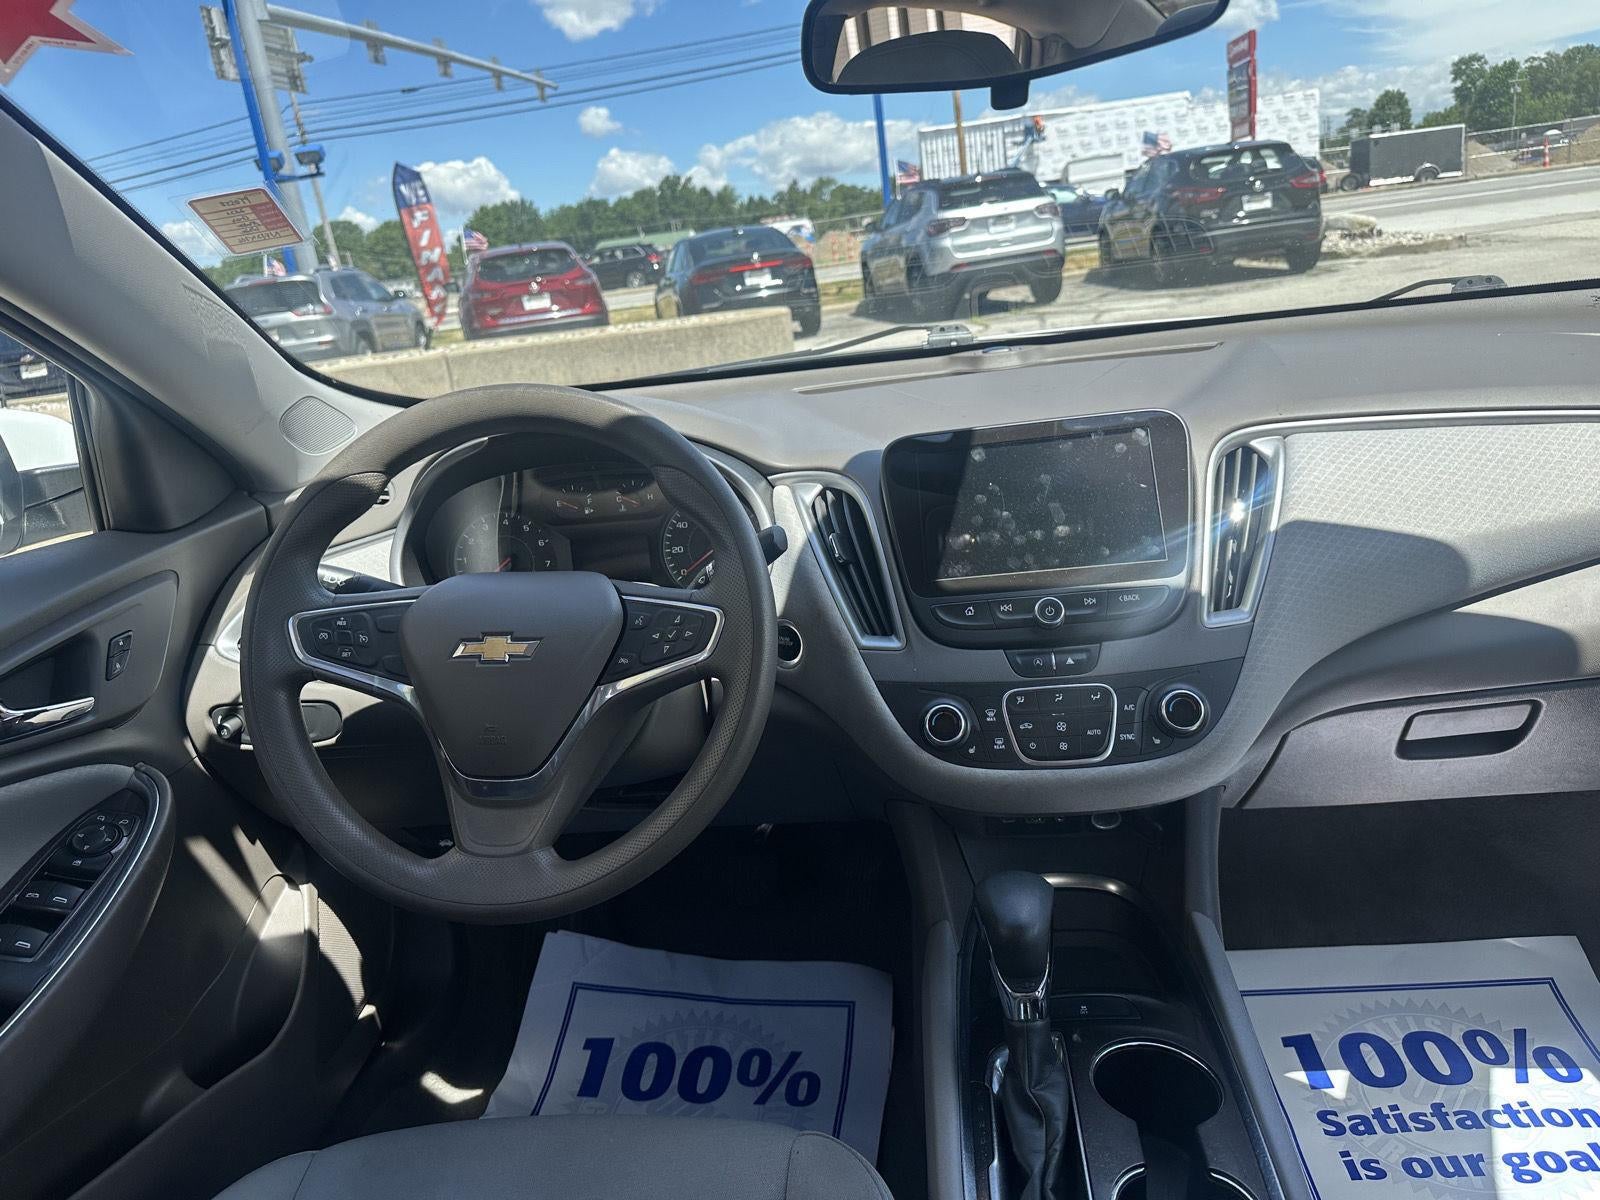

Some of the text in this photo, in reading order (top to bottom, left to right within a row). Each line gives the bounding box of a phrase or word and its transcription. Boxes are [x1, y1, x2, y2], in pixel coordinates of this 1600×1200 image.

[576, 1037, 821, 1107] 100%
[1281, 1028, 1583, 1090] 100%
[1316, 1101, 1600, 1136] Satisfaction
[1339, 1150, 1388, 1181] is
[1401, 1151, 1486, 1178] our
